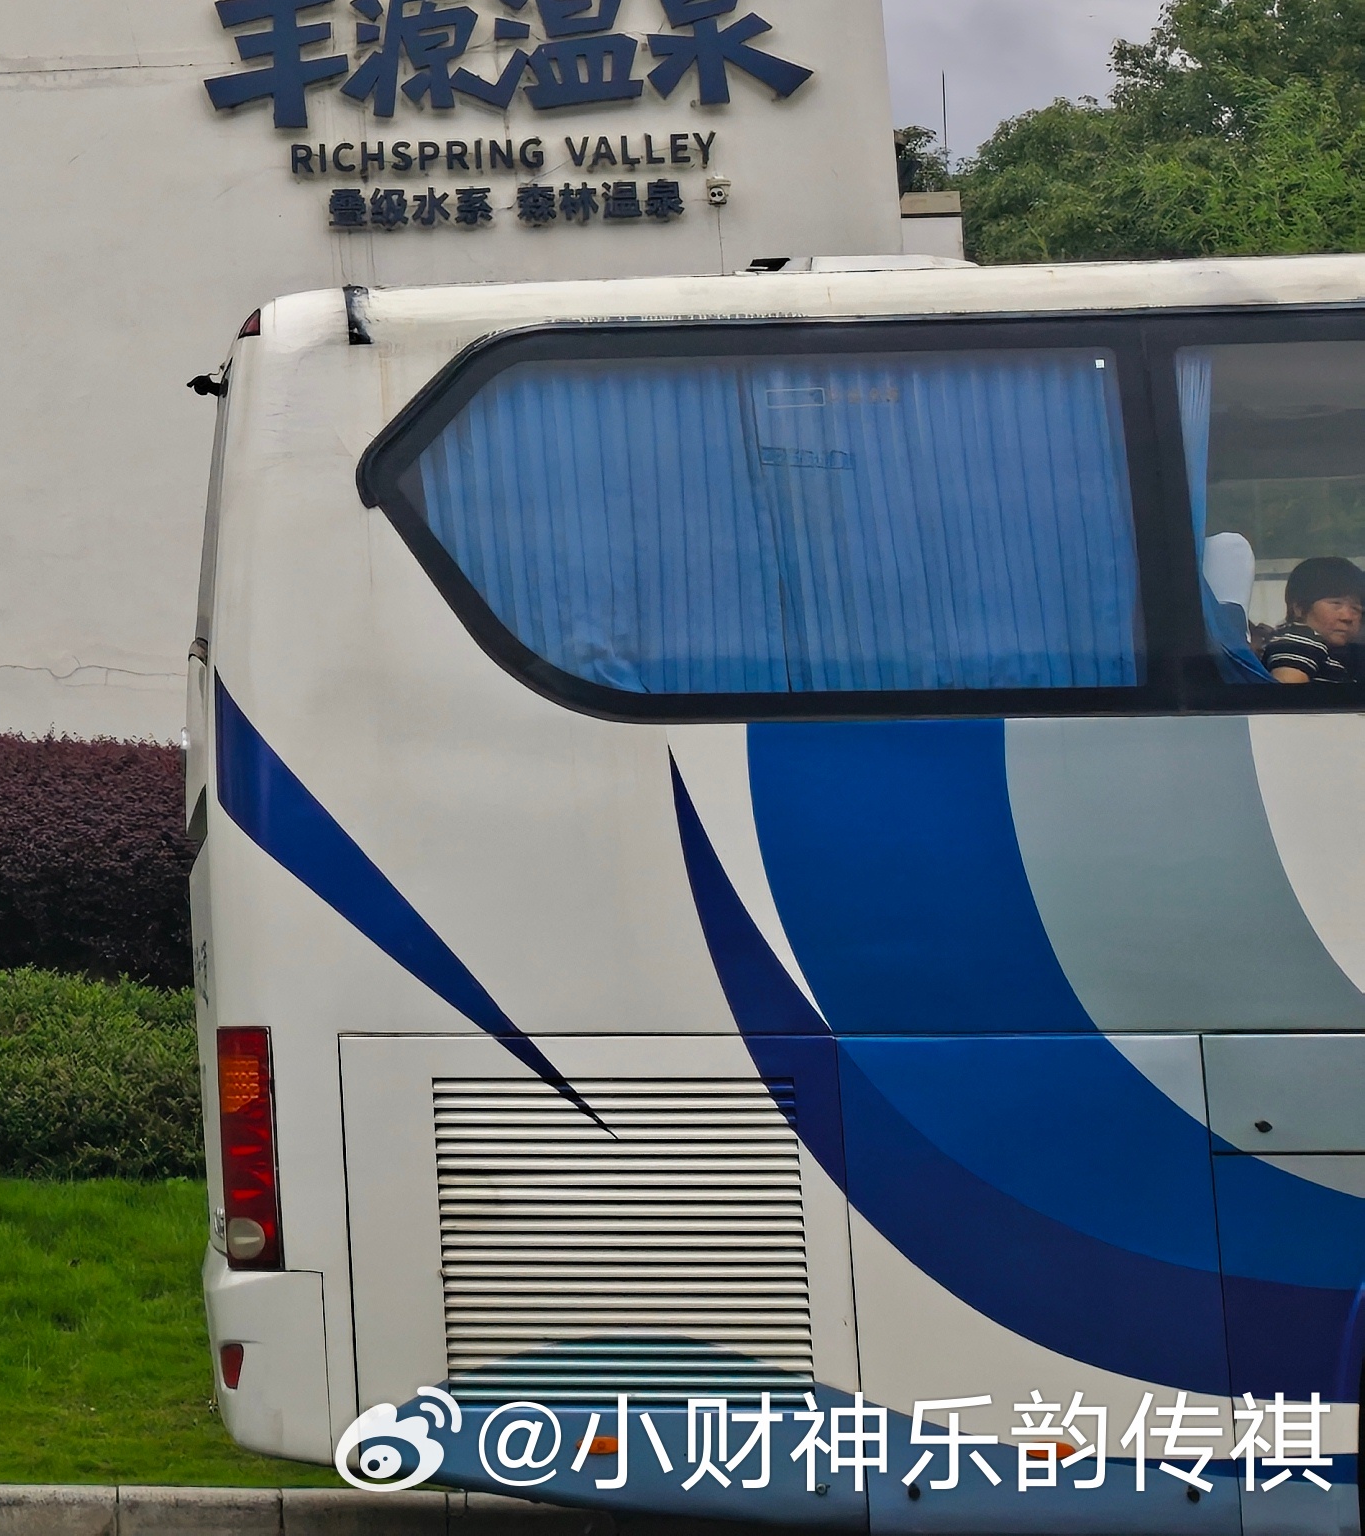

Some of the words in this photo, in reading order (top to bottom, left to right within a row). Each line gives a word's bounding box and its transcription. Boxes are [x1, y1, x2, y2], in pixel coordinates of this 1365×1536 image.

[290, 137, 545, 173] RICHSPRING
[565, 130, 717, 167] VALLEY
[516, 178, 685, 223] 森林温泉
